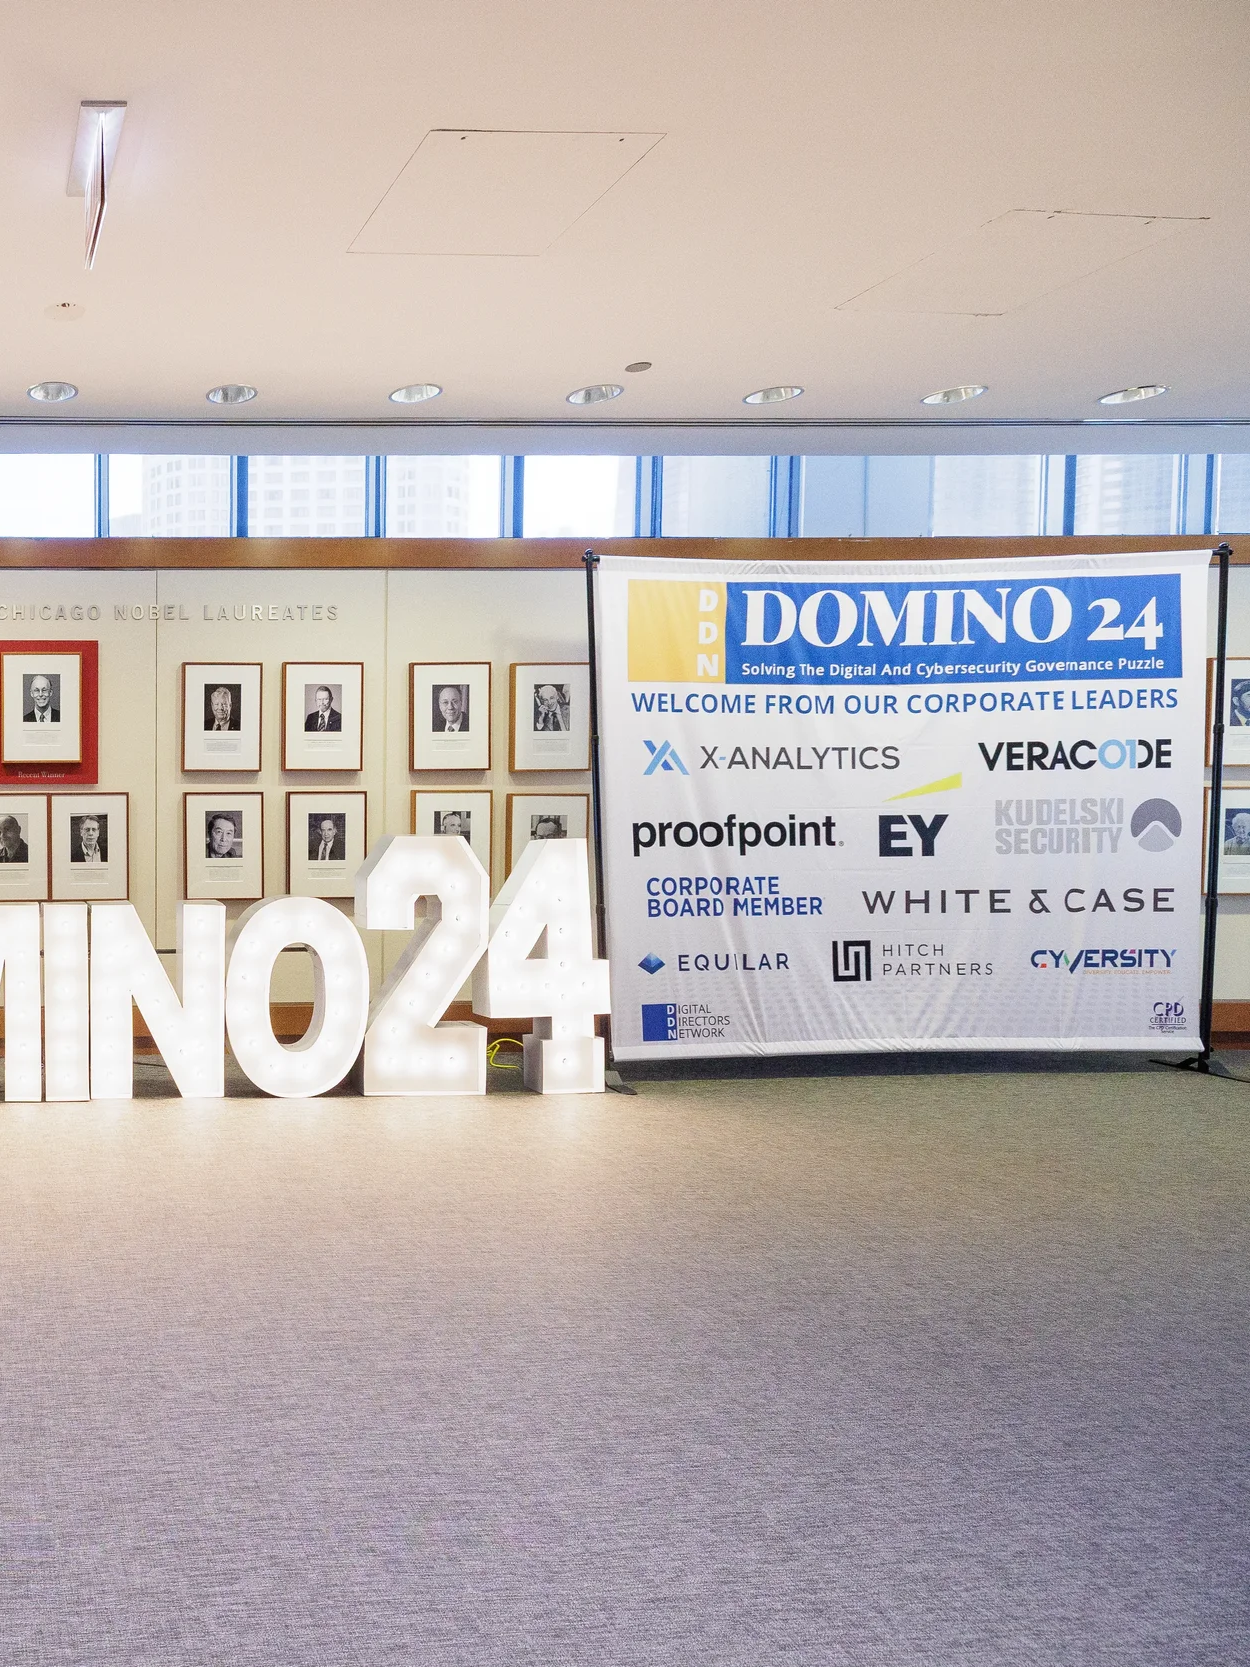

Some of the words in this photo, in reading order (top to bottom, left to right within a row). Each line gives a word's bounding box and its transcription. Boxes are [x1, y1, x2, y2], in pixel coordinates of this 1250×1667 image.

[114, 604, 189, 621] NOBEL
[204, 604, 339, 621] LAUREATES
[741, 585, 1072, 647] DOMINO
[1087, 596, 1163, 650] 24
[741, 662, 796, 679] Solving
[799, 663, 825, 677] The
[830, 663, 877, 679] Digital
[880, 662, 912, 676] And
[916, 661, 1021, 679] Cybersecurity
[1025, 659, 1113, 673] Governance
[1118, 657, 1164, 671] Puzzle
[631, 692, 756, 714] WELCOME
[766, 694, 835, 715] FROM
[844, 694, 898, 715] OUR
[907, 690, 1064, 714] CORPORATE
[1071, 688, 1178, 710] LEADERS
[700, 745, 900, 770] X-ANALYTICS
[995, 798, 1124, 826] KUDELSKI
[632, 813, 836, 857] proofpoint
[878, 814, 949, 857] EY
[995, 826, 1123, 855] SECURITY
[646, 876, 780, 896] CORPORATE
[647, 898, 724, 917] BOARD
[733, 897, 823, 916] MEMBER
[862, 889, 1011, 914] WHITE
[1029, 888, 1050, 913] &
[1064, 888, 1175, 912] CASE
[882, 943, 944, 956] HITCH
[678, 953, 790, 971] EQUILAR
[882, 963, 993, 976] PARTNERS
[1031, 949, 1177, 974] CYVERSITY
[667, 1004, 712, 1014] DIGITAL
[1153, 1002, 1184, 1016] CPD
[667, 1016, 730, 1027] DIRECTORS
[668, 1027, 725, 1039] NETWORK
